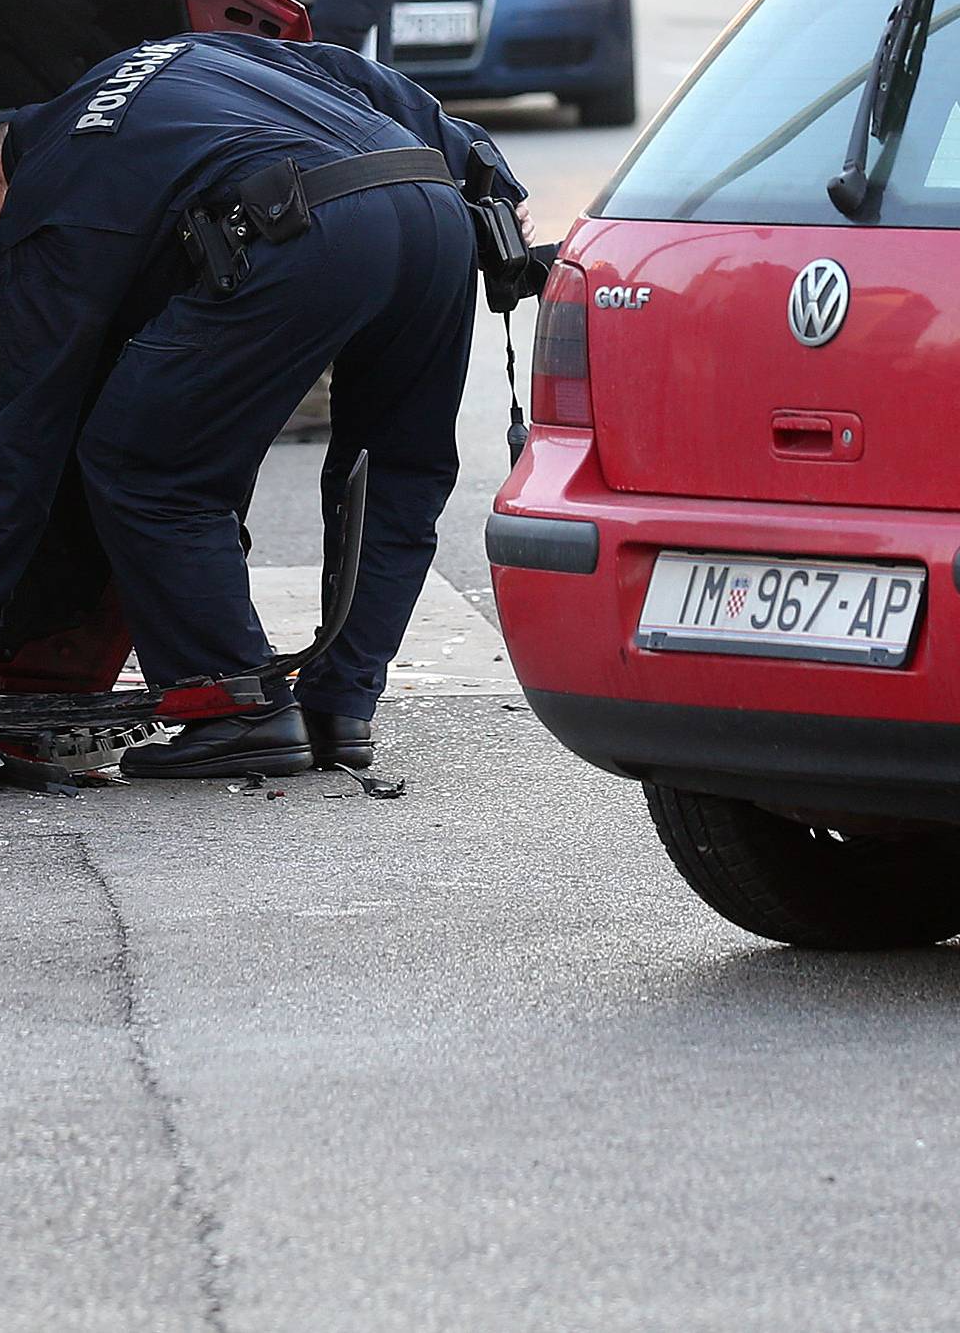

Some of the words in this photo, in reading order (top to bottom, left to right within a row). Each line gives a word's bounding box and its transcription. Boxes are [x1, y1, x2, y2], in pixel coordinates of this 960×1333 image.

[76, 42, 188, 129] POLICIJA
[594, 285, 651, 309] GOLF
[678, 566, 730, 625] IM
